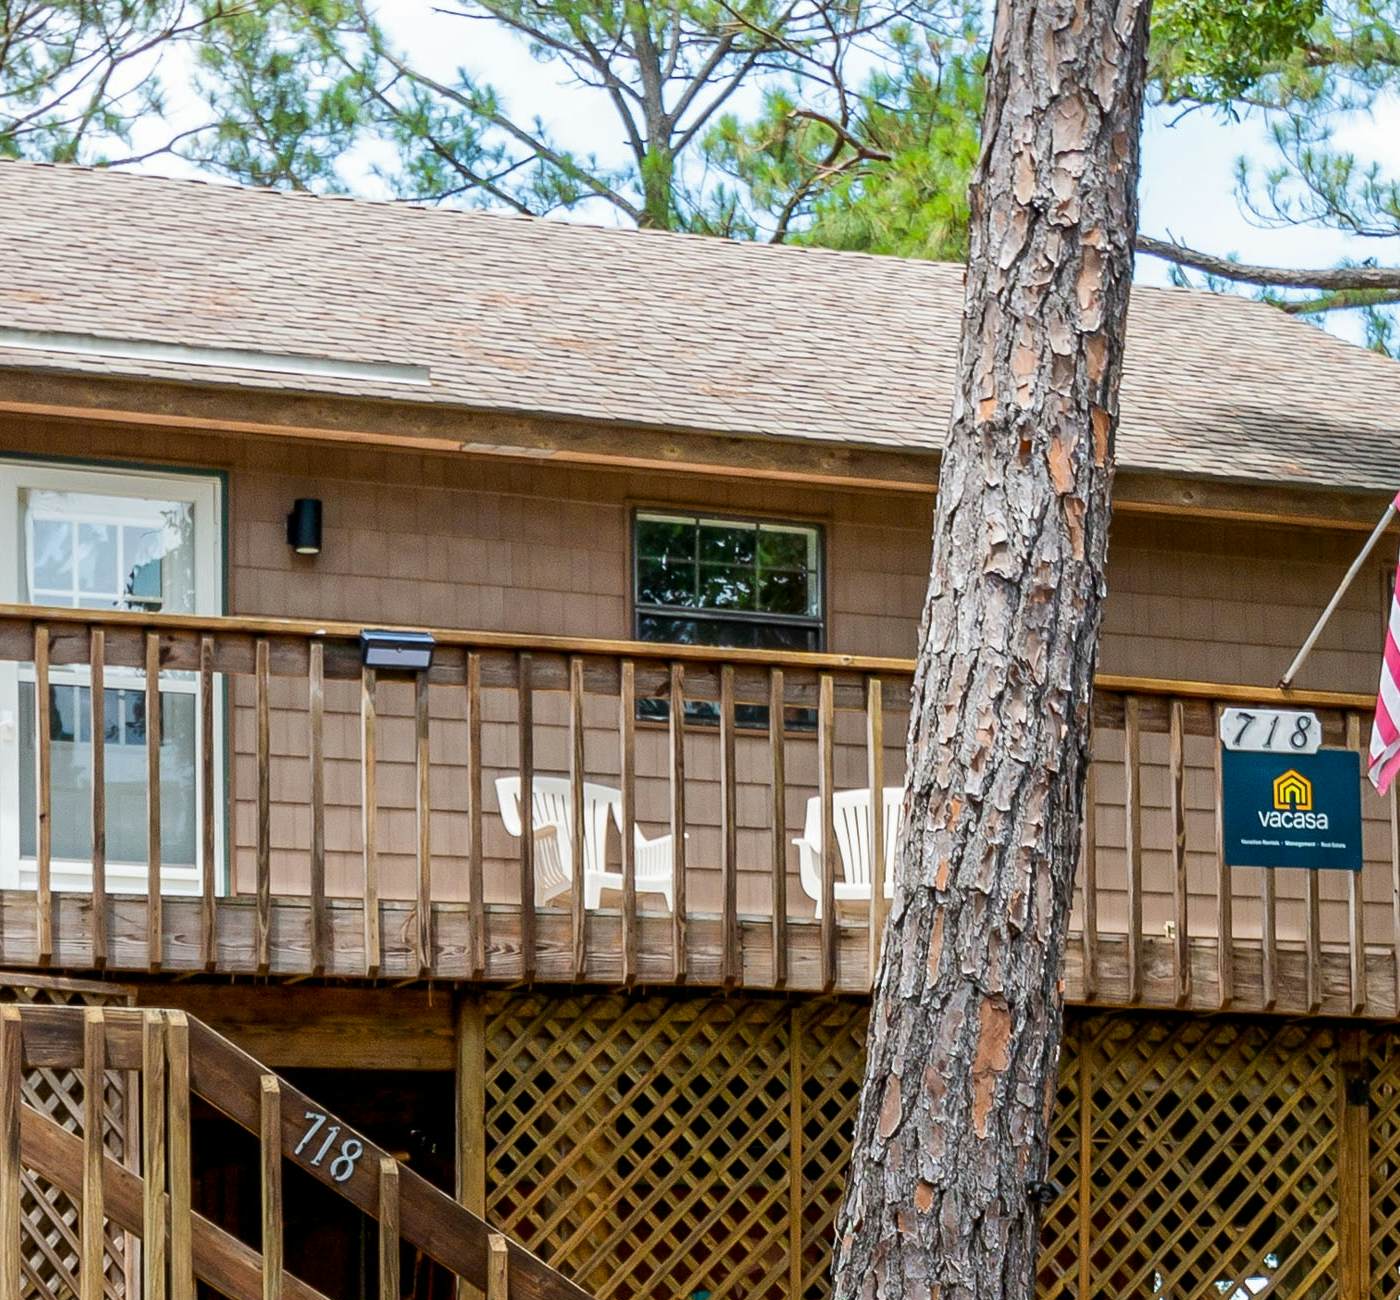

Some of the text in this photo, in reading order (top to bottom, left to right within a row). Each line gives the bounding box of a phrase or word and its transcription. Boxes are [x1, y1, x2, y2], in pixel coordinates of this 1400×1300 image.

[1232, 711, 1312, 749] 718
[1258, 810, 1329, 830] vacasa
[294, 1111, 363, 1182] 718
